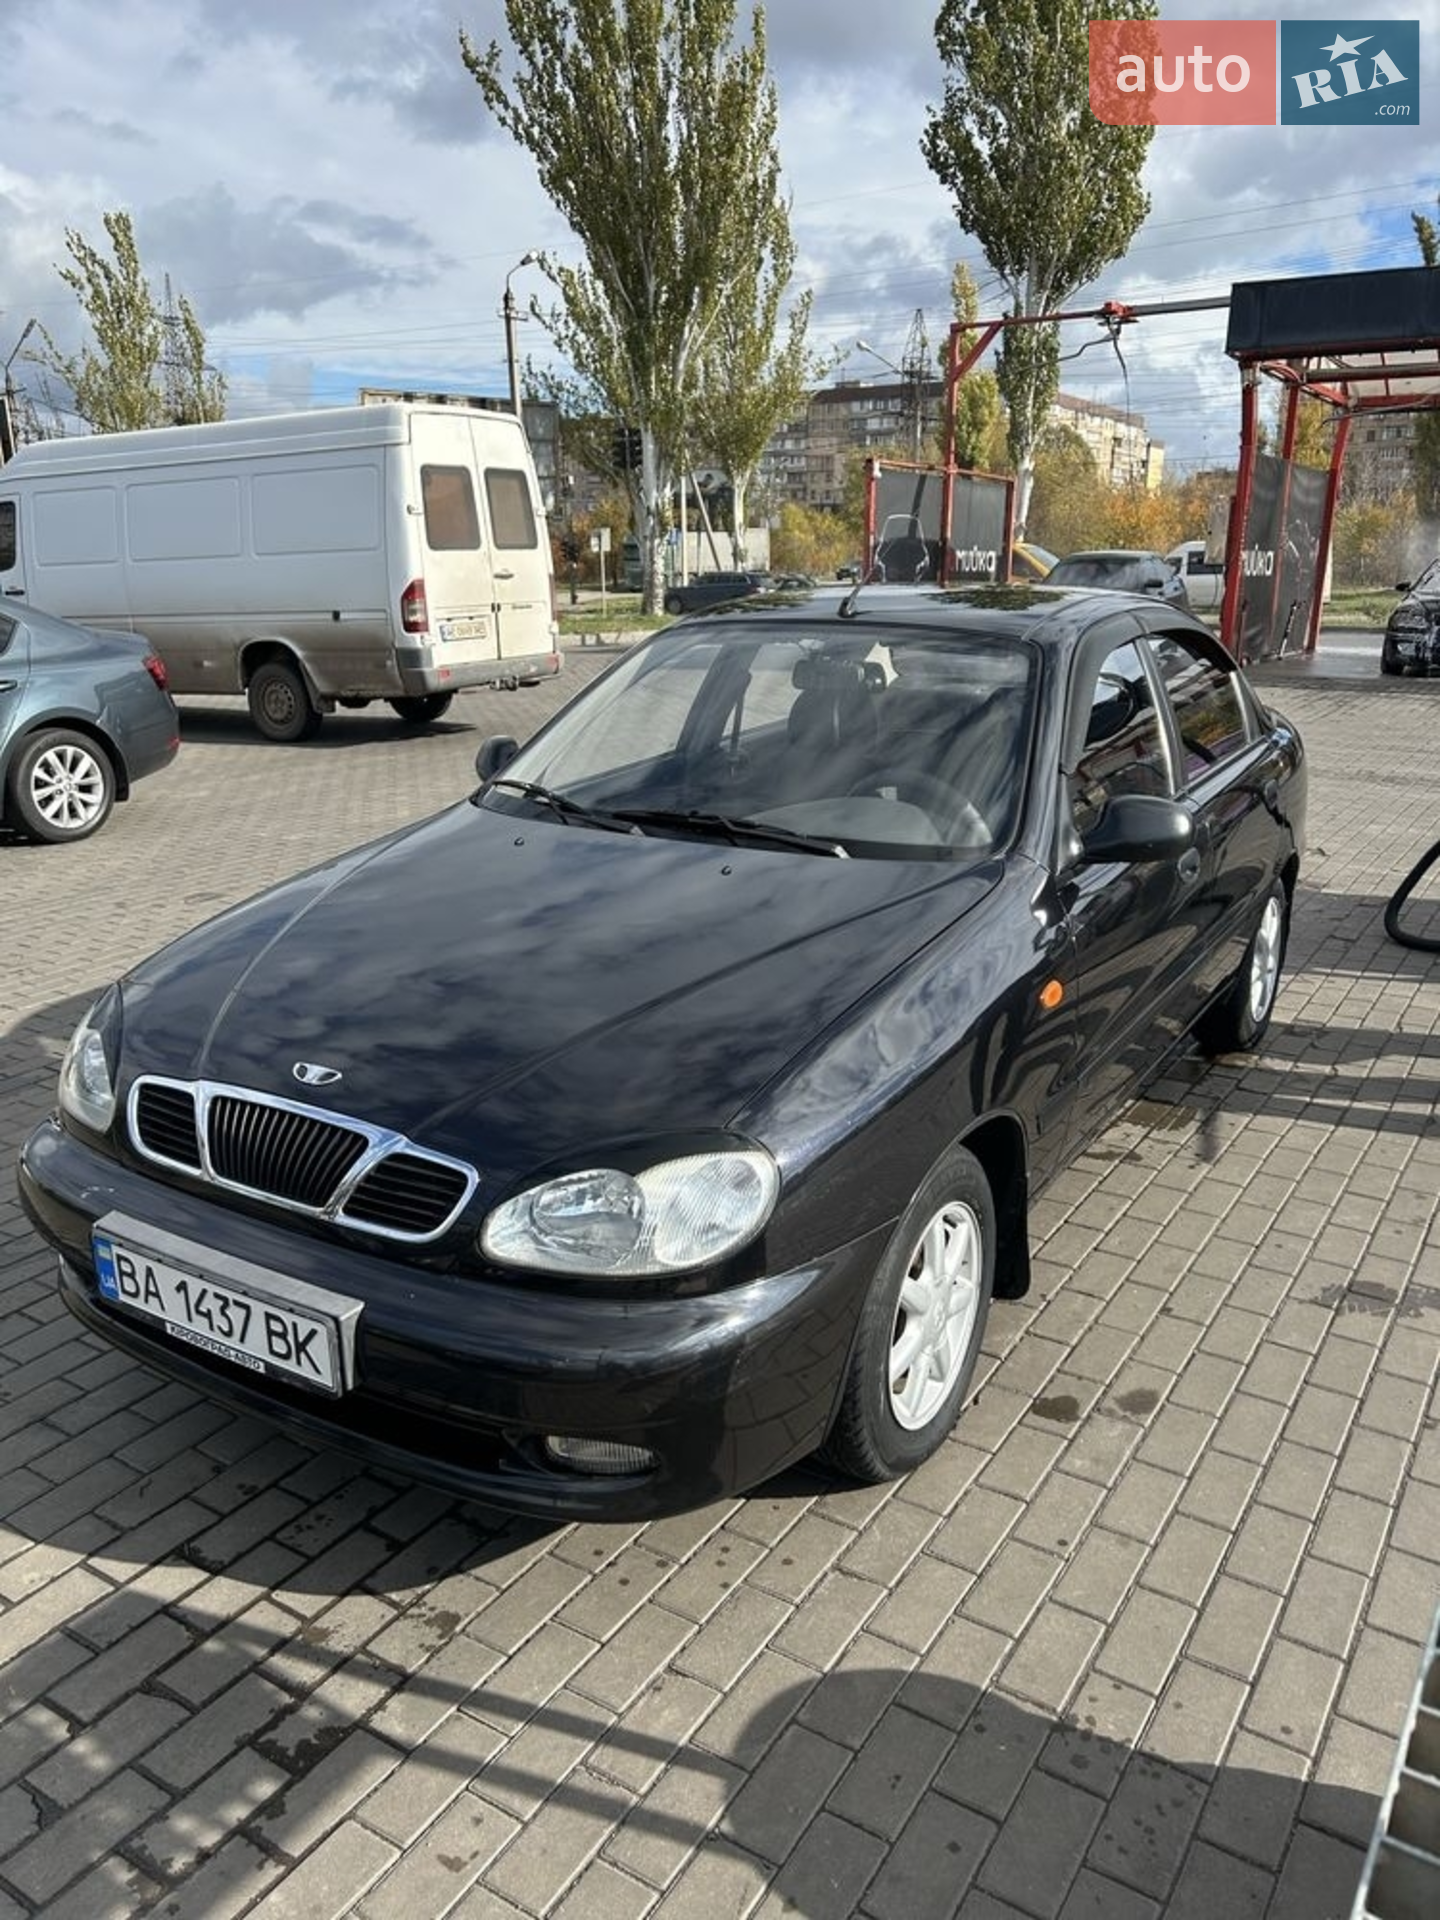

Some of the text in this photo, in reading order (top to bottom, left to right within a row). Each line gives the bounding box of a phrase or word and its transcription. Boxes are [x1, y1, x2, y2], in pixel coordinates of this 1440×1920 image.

[115, 1253, 322, 1376] BA 1437 BK
